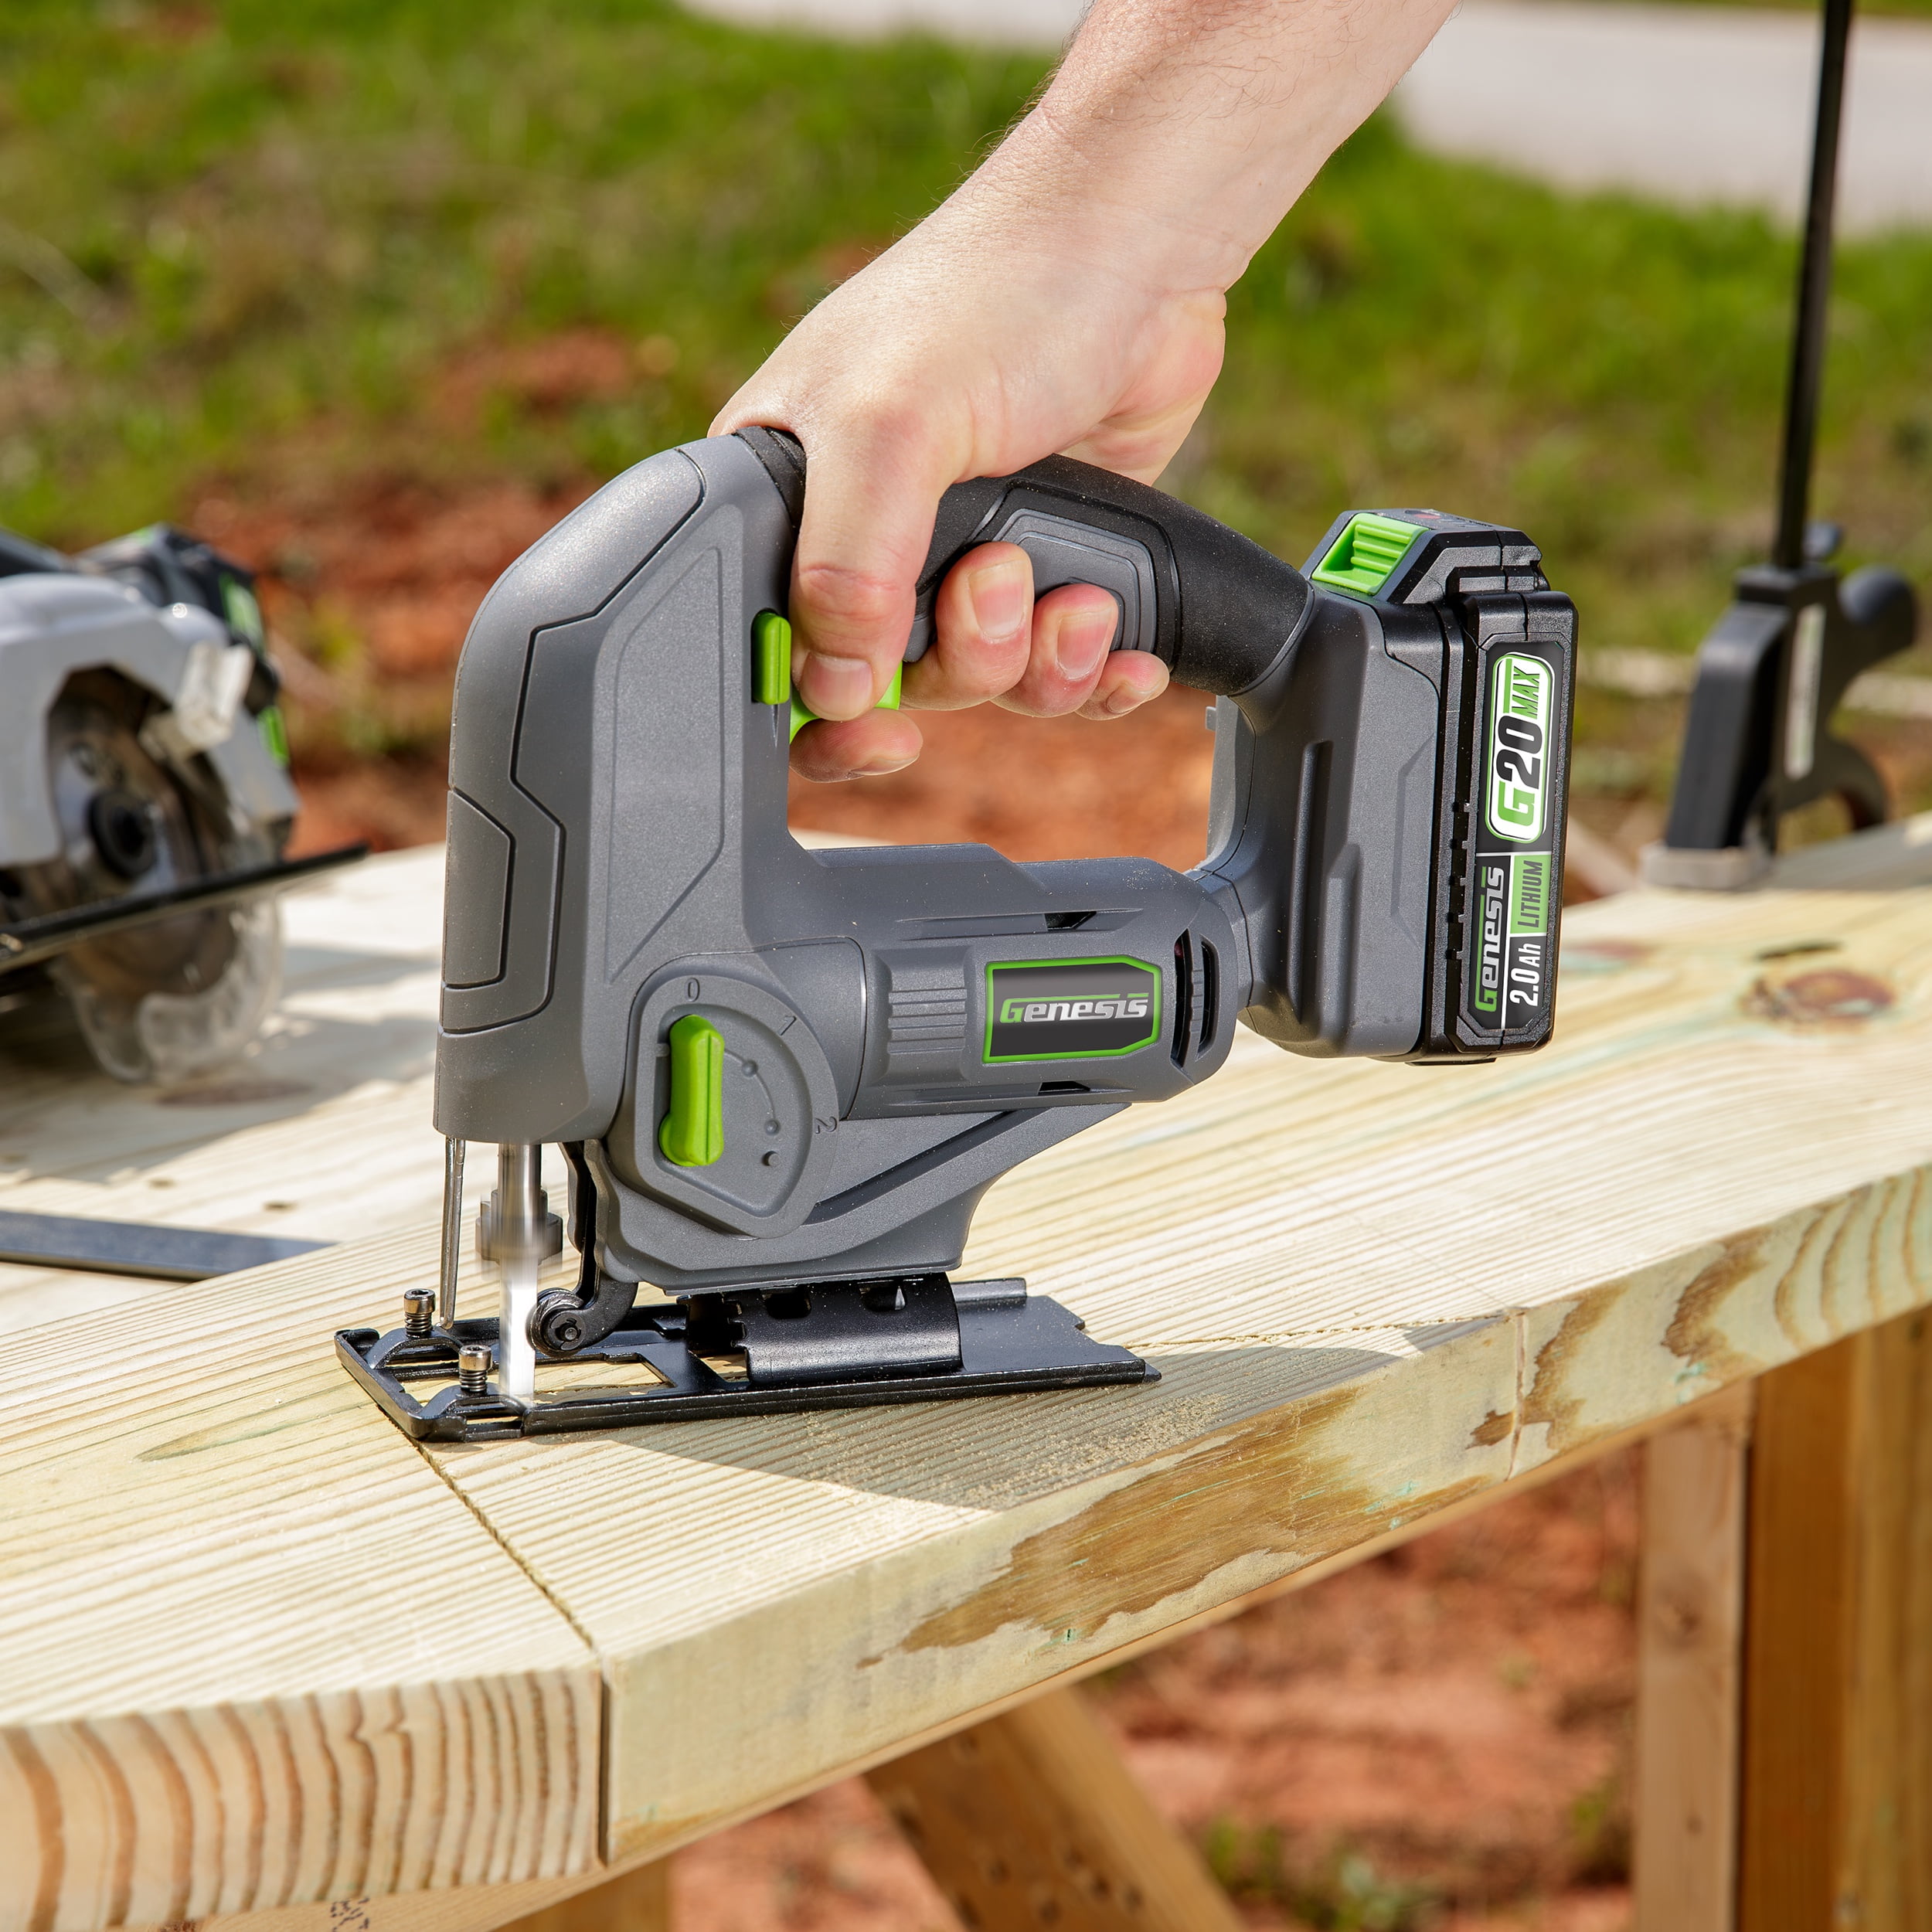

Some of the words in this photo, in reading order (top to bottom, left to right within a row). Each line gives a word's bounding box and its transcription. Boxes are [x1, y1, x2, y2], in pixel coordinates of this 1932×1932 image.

[1512, 665, 1540, 719] MAX
[1495, 715, 1543, 827] G20
[1517, 859, 1543, 928] LITHIUM
[1475, 866, 1505, 1012] Genesis
[778, 1015, 797, 1036] 1
[1000, 993, 1149, 1023] Genesis
[815, 1116, 838, 1134] 2
